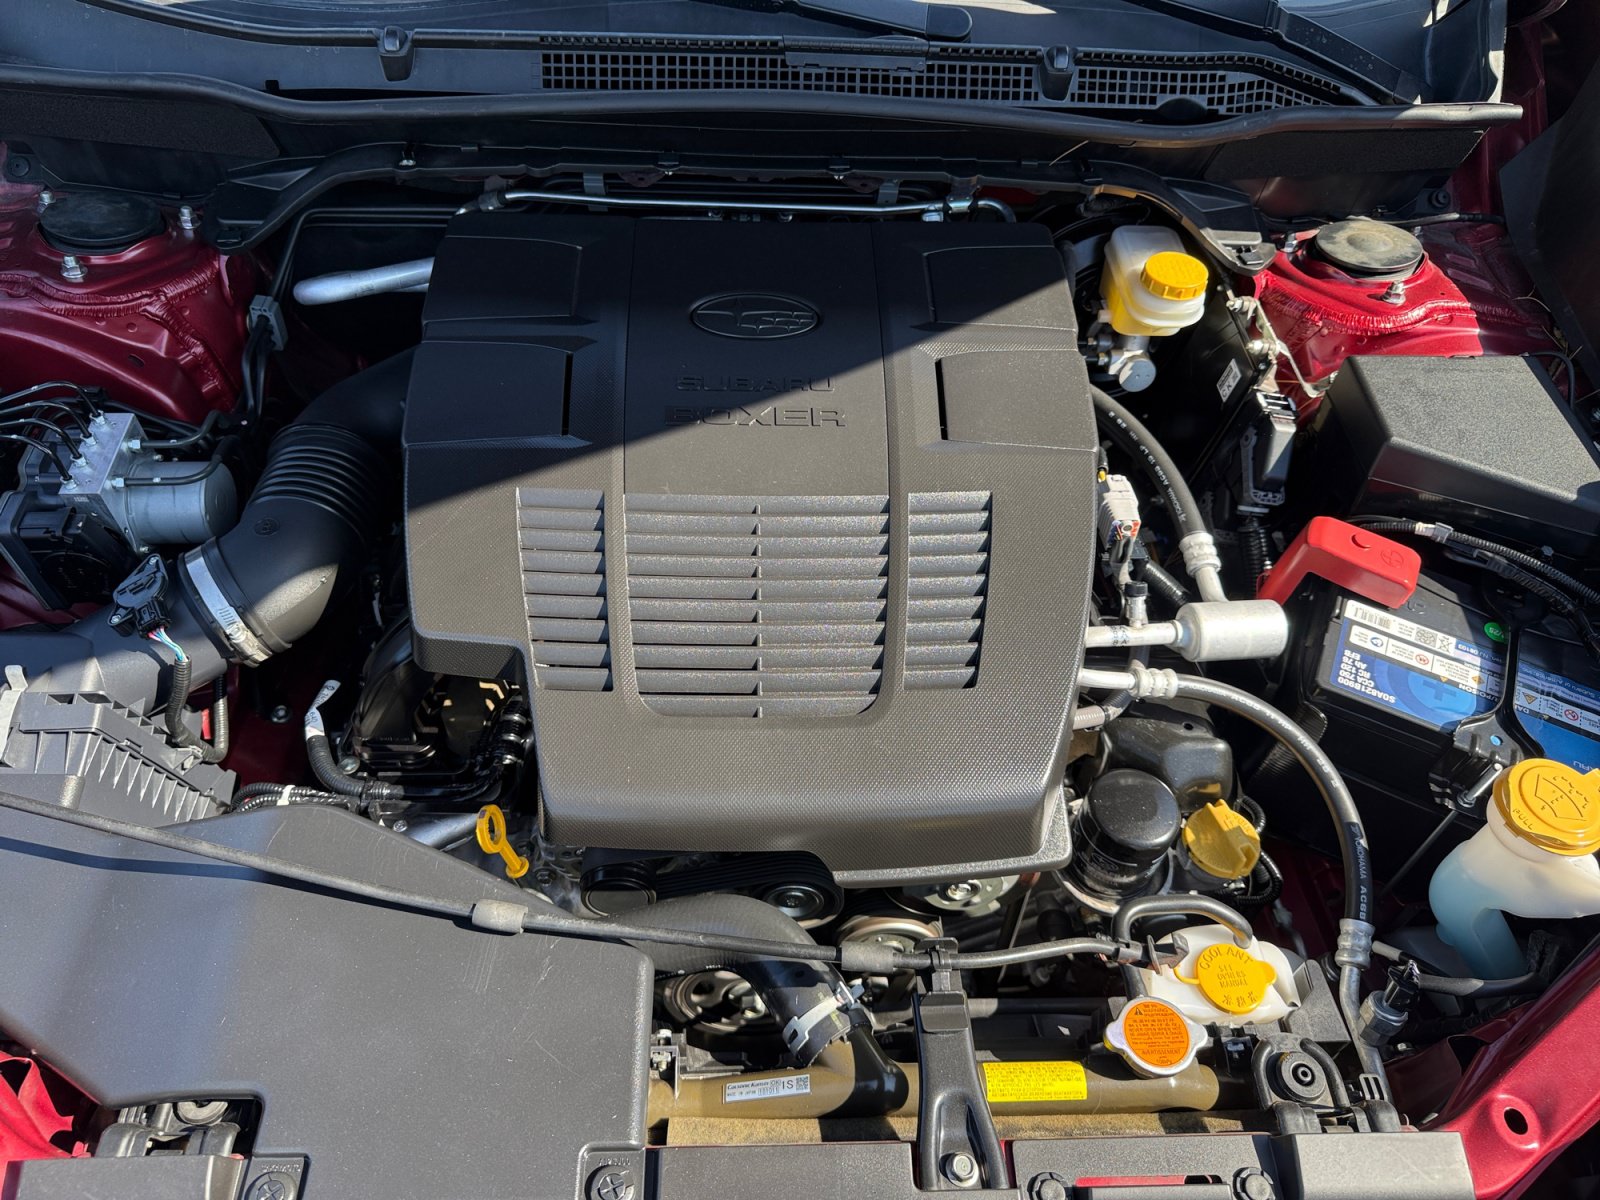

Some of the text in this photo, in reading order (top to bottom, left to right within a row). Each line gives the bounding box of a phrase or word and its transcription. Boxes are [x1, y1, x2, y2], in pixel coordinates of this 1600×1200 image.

[676, 376, 835, 392] SUBARU
[665, 406, 847, 427] BOXER
[1343, 648, 1361, 659] EFB
[1340, 662, 1370, 678] RC 120
[1353, 659, 1366, 669] Ah
[1338, 668, 1374, 687] CCA 750
[1354, 836, 1366, 878] YOKOHAMA
[1199, 946, 1254, 971] COOLANT
[1219, 978, 1248, 989] MANUAL
